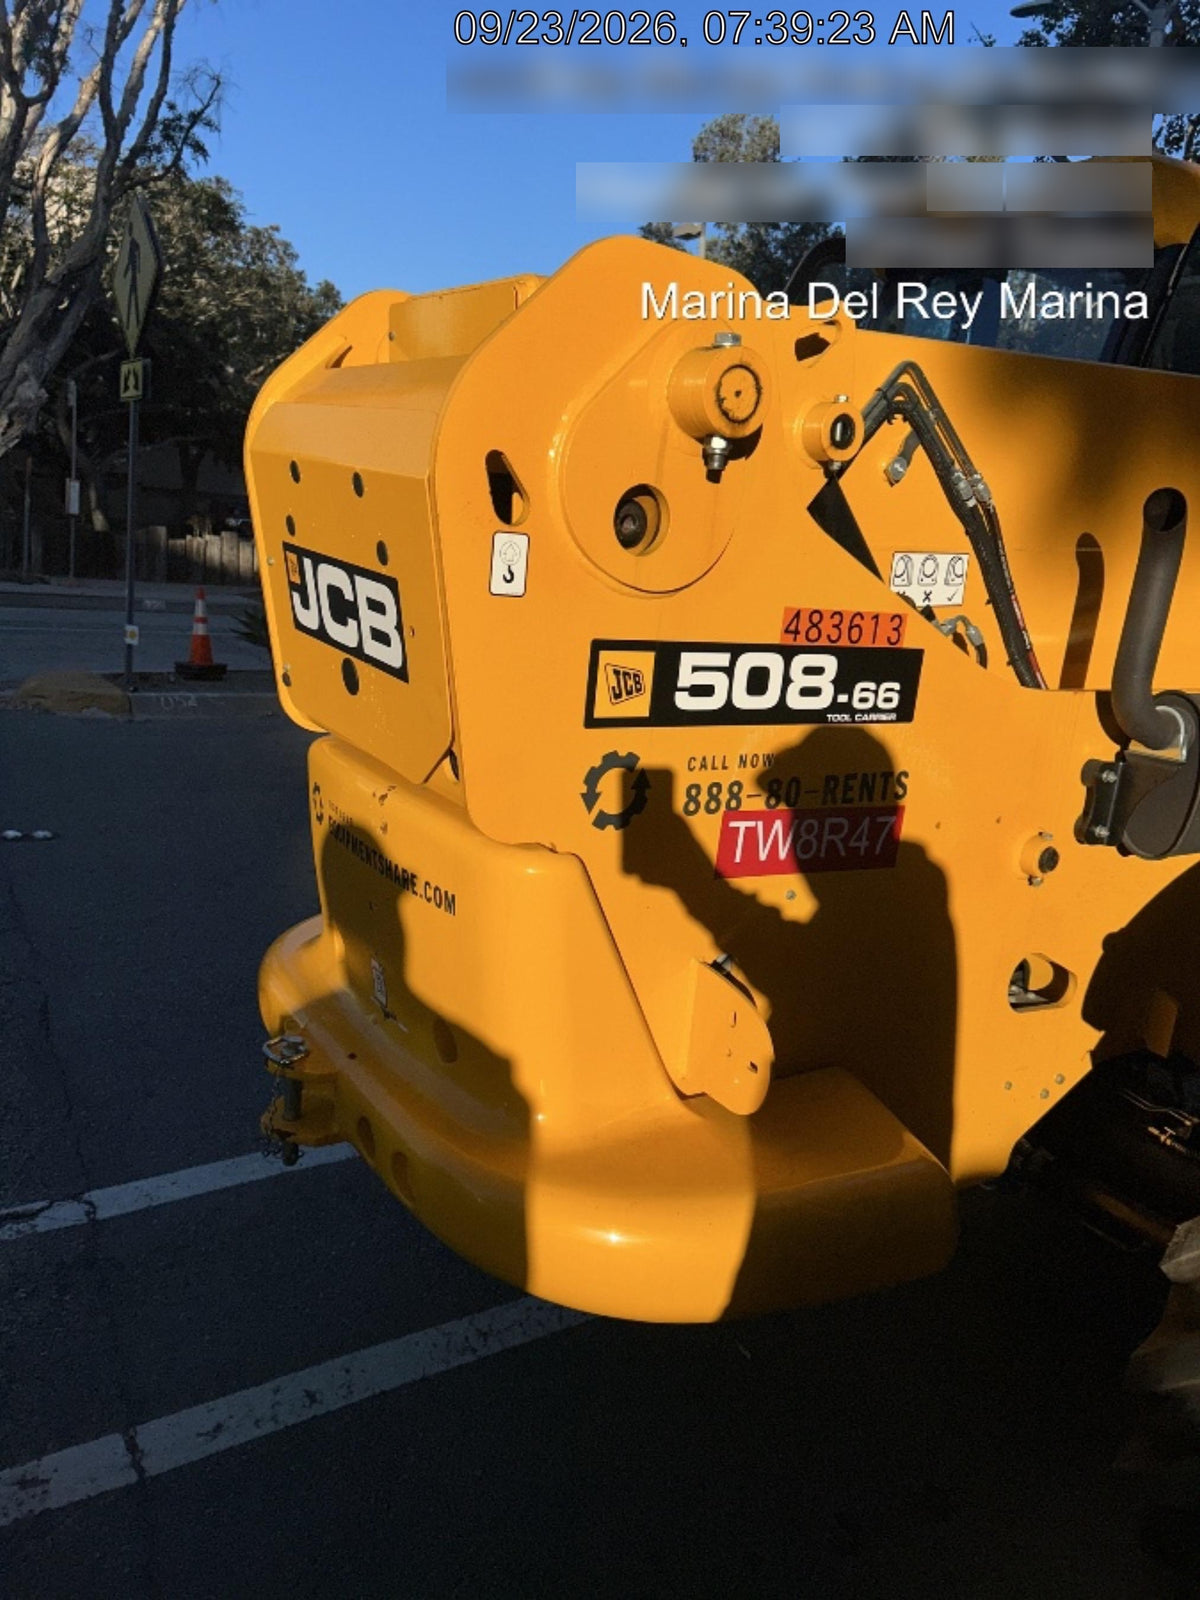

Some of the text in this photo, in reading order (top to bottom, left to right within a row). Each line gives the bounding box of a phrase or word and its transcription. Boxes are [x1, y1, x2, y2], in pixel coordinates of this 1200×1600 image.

[291, 556, 404, 670] JCB
[783, 608, 904, 647] 483613
[611, 667, 644, 701] JCB
[826, 713, 852, 723] TOOL
[687, 752, 777, 773] CALL NOW
[682, 770, 910, 817] 888-80-RENTS
[727, 815, 898, 864] TW8R47
